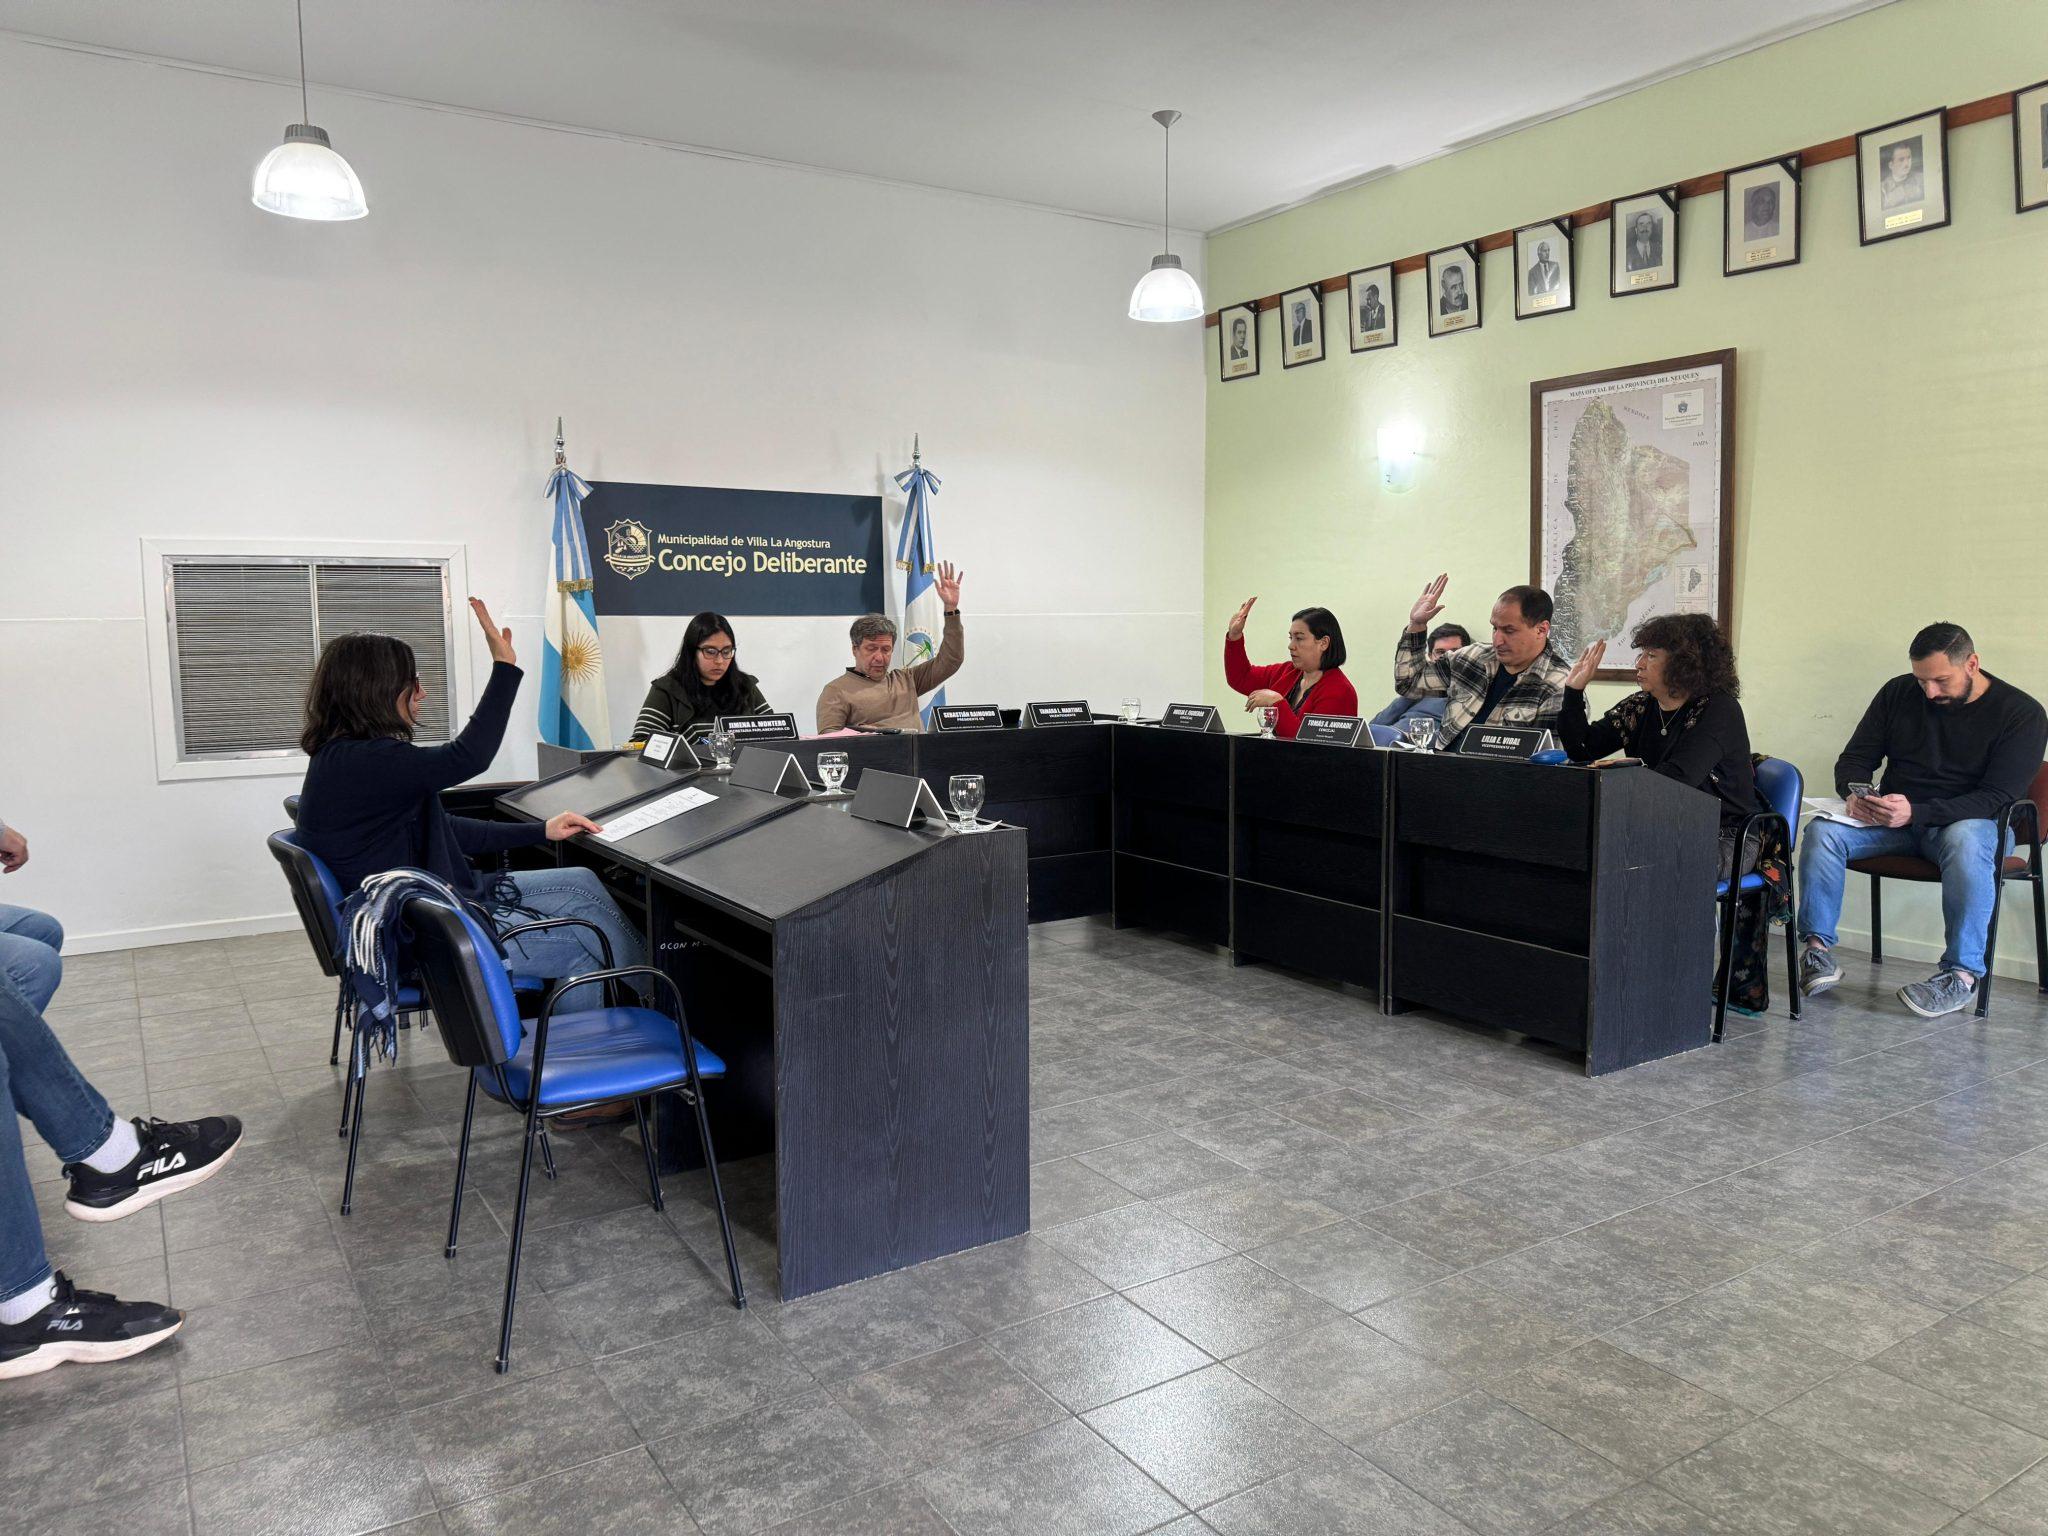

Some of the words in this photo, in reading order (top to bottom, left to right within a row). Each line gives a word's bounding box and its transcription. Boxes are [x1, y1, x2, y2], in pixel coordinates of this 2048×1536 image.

[1585, 387, 1607, 395] OFICIAL
[1625, 379, 1657, 389] PROVINCIA
[657, 533, 728, 547] Municipalidad
[731, 535, 744, 547] de
[746, 536, 768, 548] Villa
[770, 537, 783, 548] La
[784, 538, 831, 550] Angostura
[658, 549, 746, 577] Concejo
[753, 551, 867, 574] Deliberante
[728, 721, 751, 729] JIMENA
[757, 720, 787, 728] MONTERO
[1329, 721, 1353, 729] ANDRADE
[1481, 735, 1496, 744] LILIA
[1502, 737, 1521, 746] VIDAL
[137, 1152, 187, 1180] FILA
[47, 1319, 83, 1331] FILA
